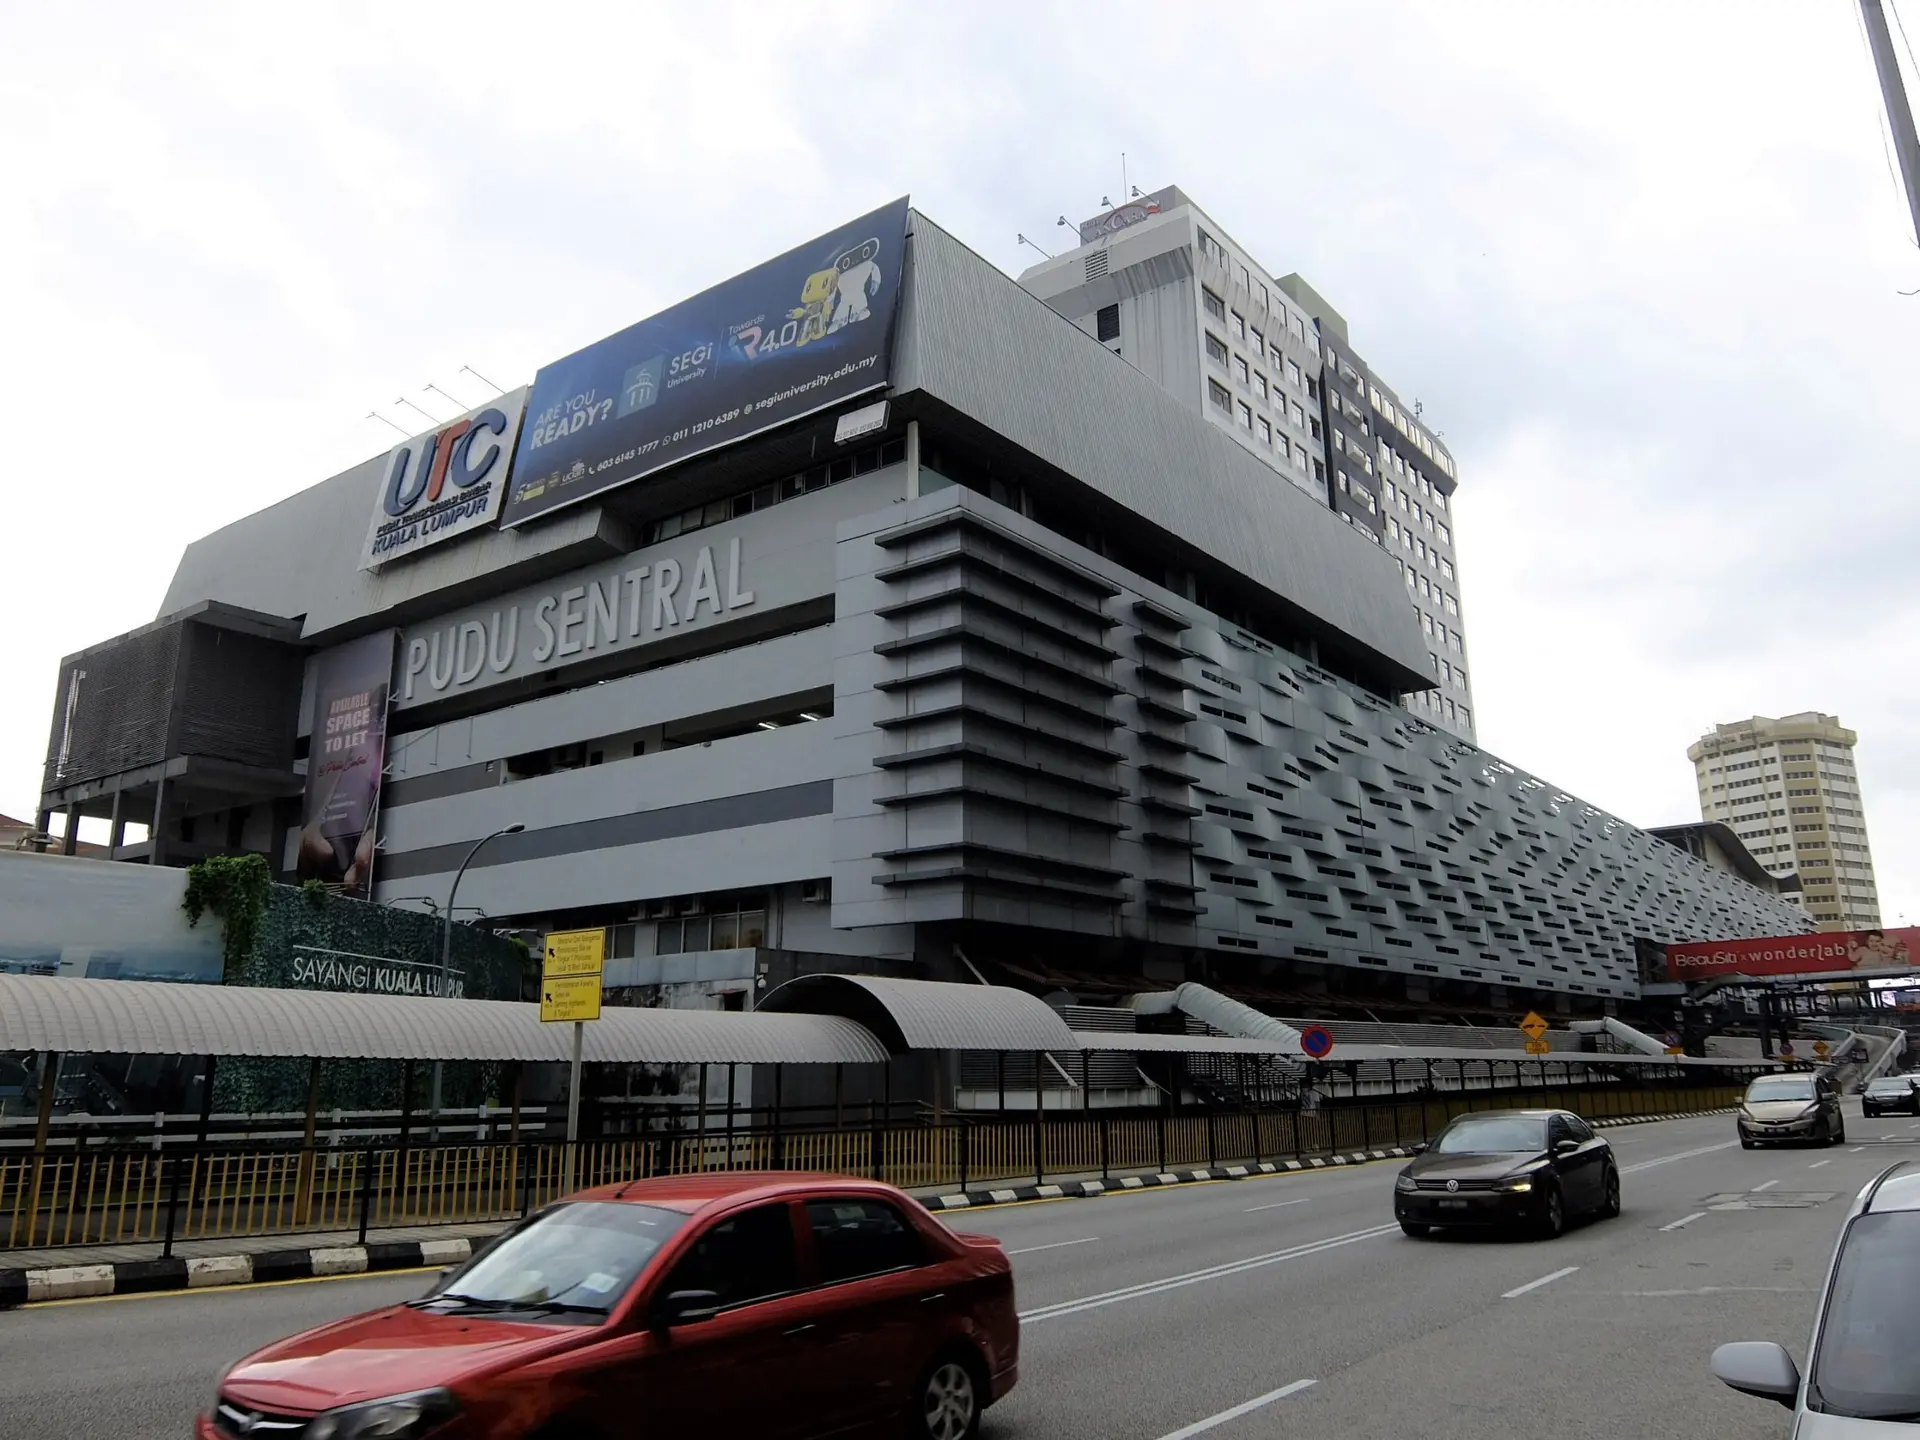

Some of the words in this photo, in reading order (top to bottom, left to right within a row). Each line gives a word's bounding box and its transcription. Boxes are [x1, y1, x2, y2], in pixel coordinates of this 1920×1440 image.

[728, 314, 765, 335] Towards
[667, 367, 707, 389] University
[530, 398, 613, 450] READY?
[533, 404, 561, 429] ARE
[565, 389, 595, 411] YOU
[597, 457, 614, 472] 603
[615, 450, 635, 465] 6145
[638, 440, 660, 455] 1777
[672, 428, 689, 442] 011
[692, 418, 714, 435] 1210
[714, 409, 740, 426] 6389
[755, 354, 877, 411] segiuniversity.edu.my
[383, 407, 507, 517] UTC
[372, 524, 417, 555] KUALA
[421, 496, 488, 536] LUMPUR
[404, 606, 518, 700] PUDU
[532, 536, 755, 663] SENTRAL
[326, 708, 371, 734] SPACE
[331, 691, 370, 714] AVAILABLE
[324, 736, 343, 753] TO
[343, 730, 368, 748] LET
[292, 957, 371, 989] SAYANGI
[374, 968, 422, 994] KUALA
[426, 973, 464, 1000] LUPUR
